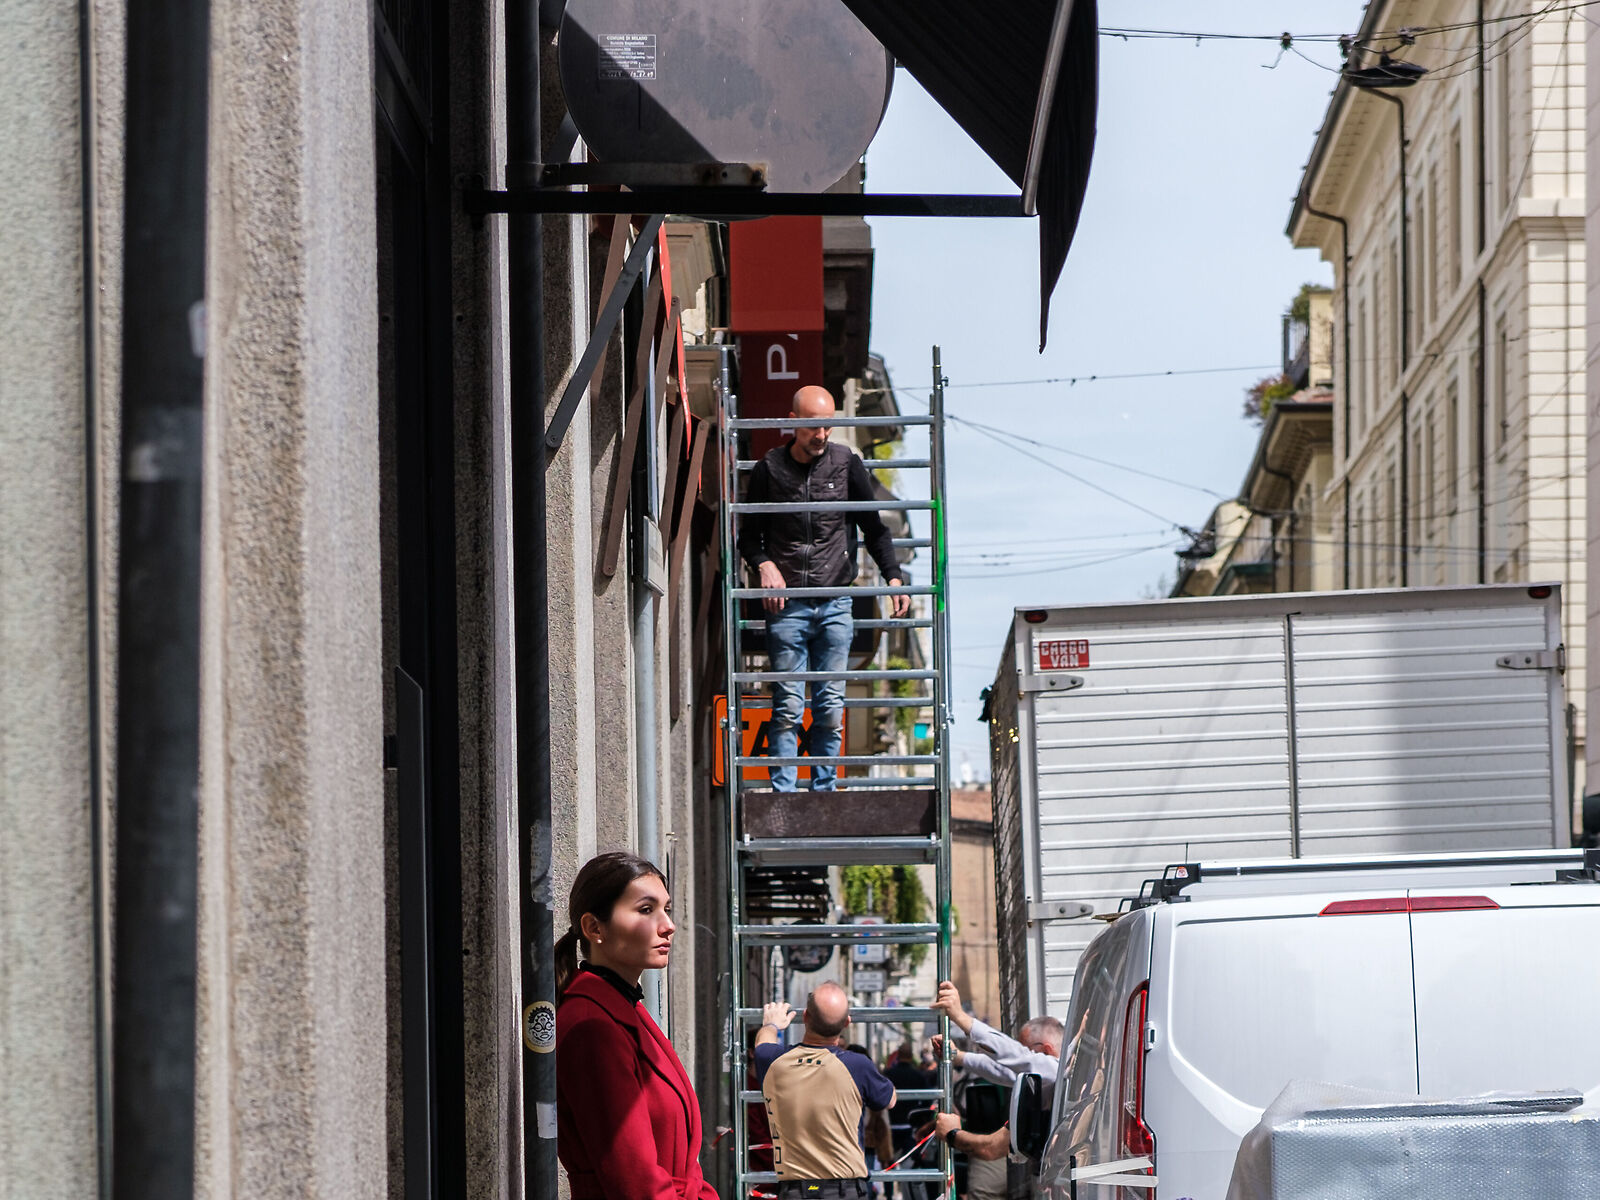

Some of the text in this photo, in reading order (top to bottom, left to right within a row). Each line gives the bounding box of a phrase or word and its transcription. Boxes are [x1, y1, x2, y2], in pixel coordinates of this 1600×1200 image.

[766, 333, 799, 380] P
[1041, 641, 1087, 656] CARGO
[1050, 654, 1079, 668] VAN
